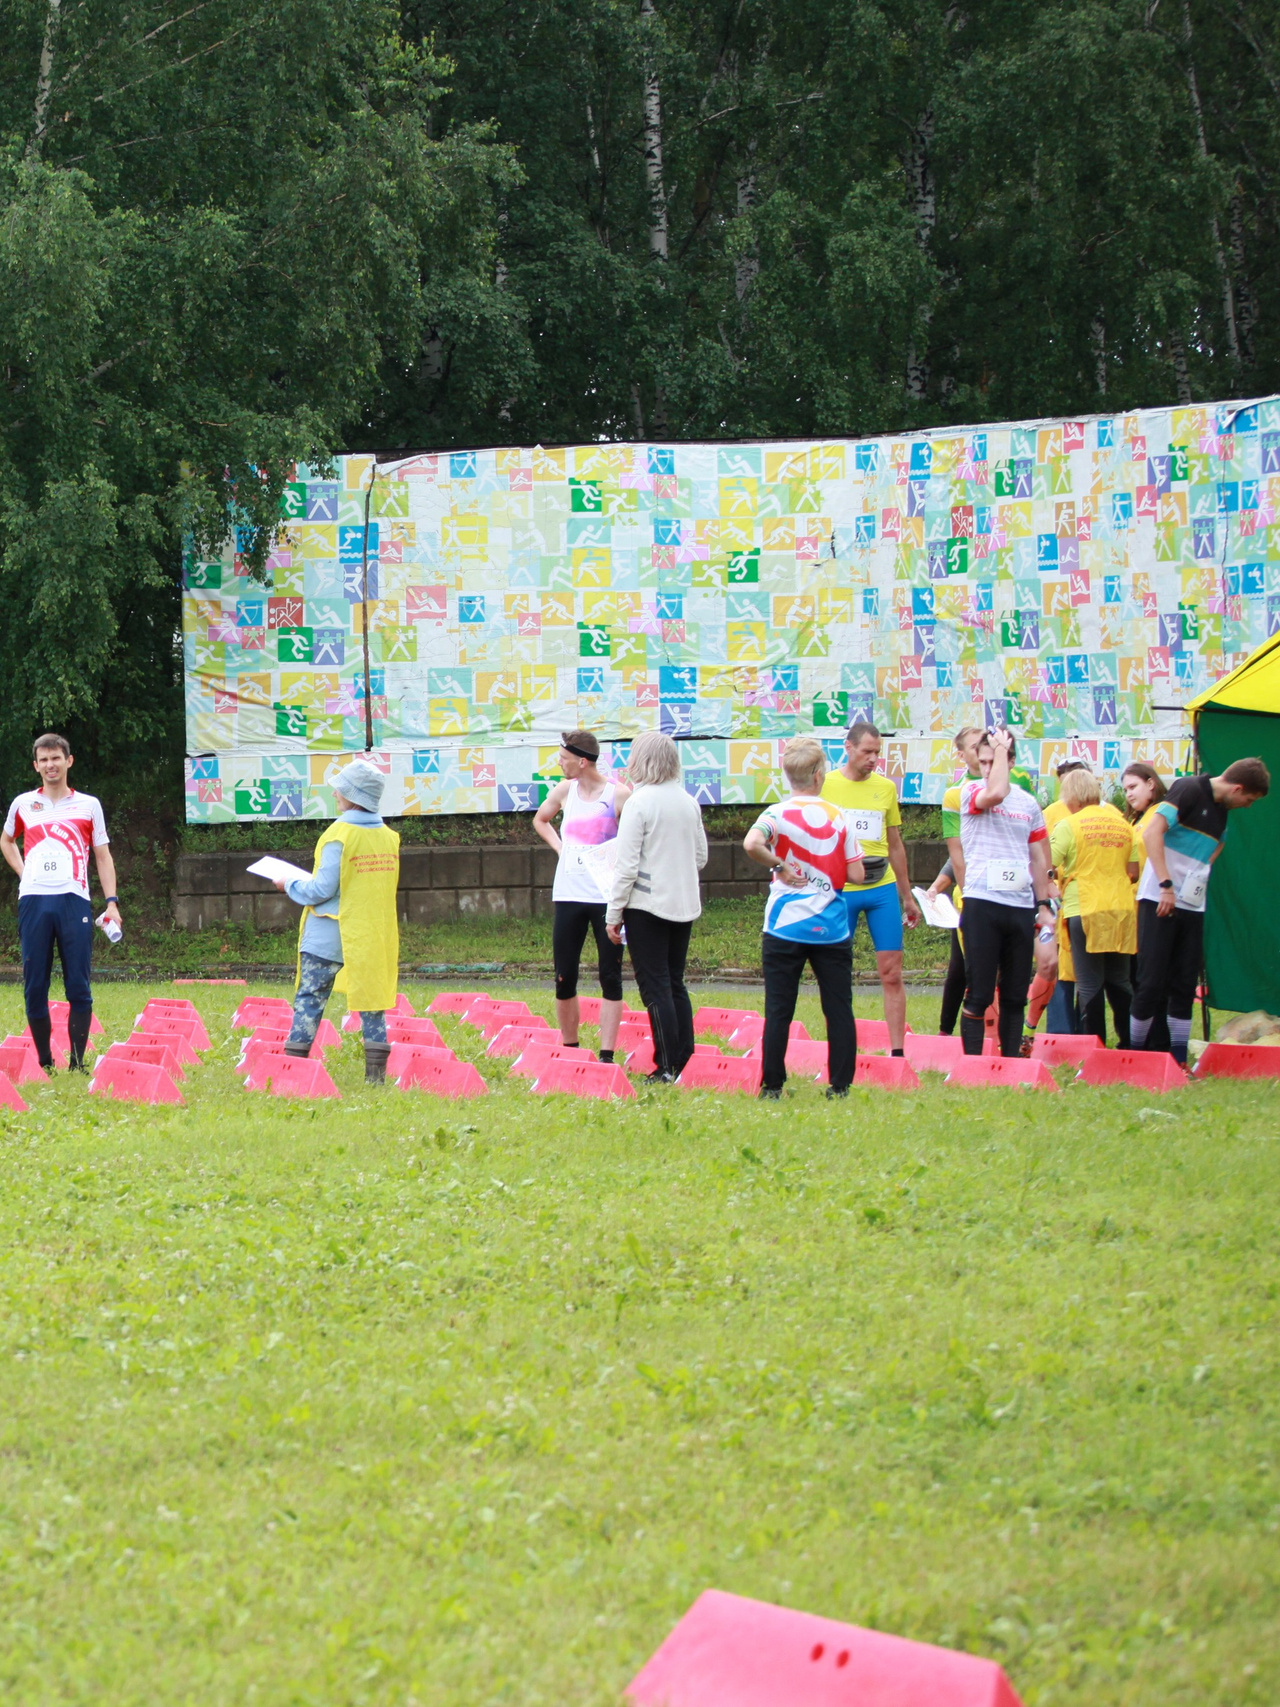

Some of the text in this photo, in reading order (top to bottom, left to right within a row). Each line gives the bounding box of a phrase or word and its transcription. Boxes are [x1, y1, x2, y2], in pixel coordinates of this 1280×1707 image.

[855, 820, 869, 831] 63
[50, 824, 69, 840] Run
[67, 839, 82, 857] and
[43, 861, 57, 871] 68
[1002, 871, 1015, 882] 52
